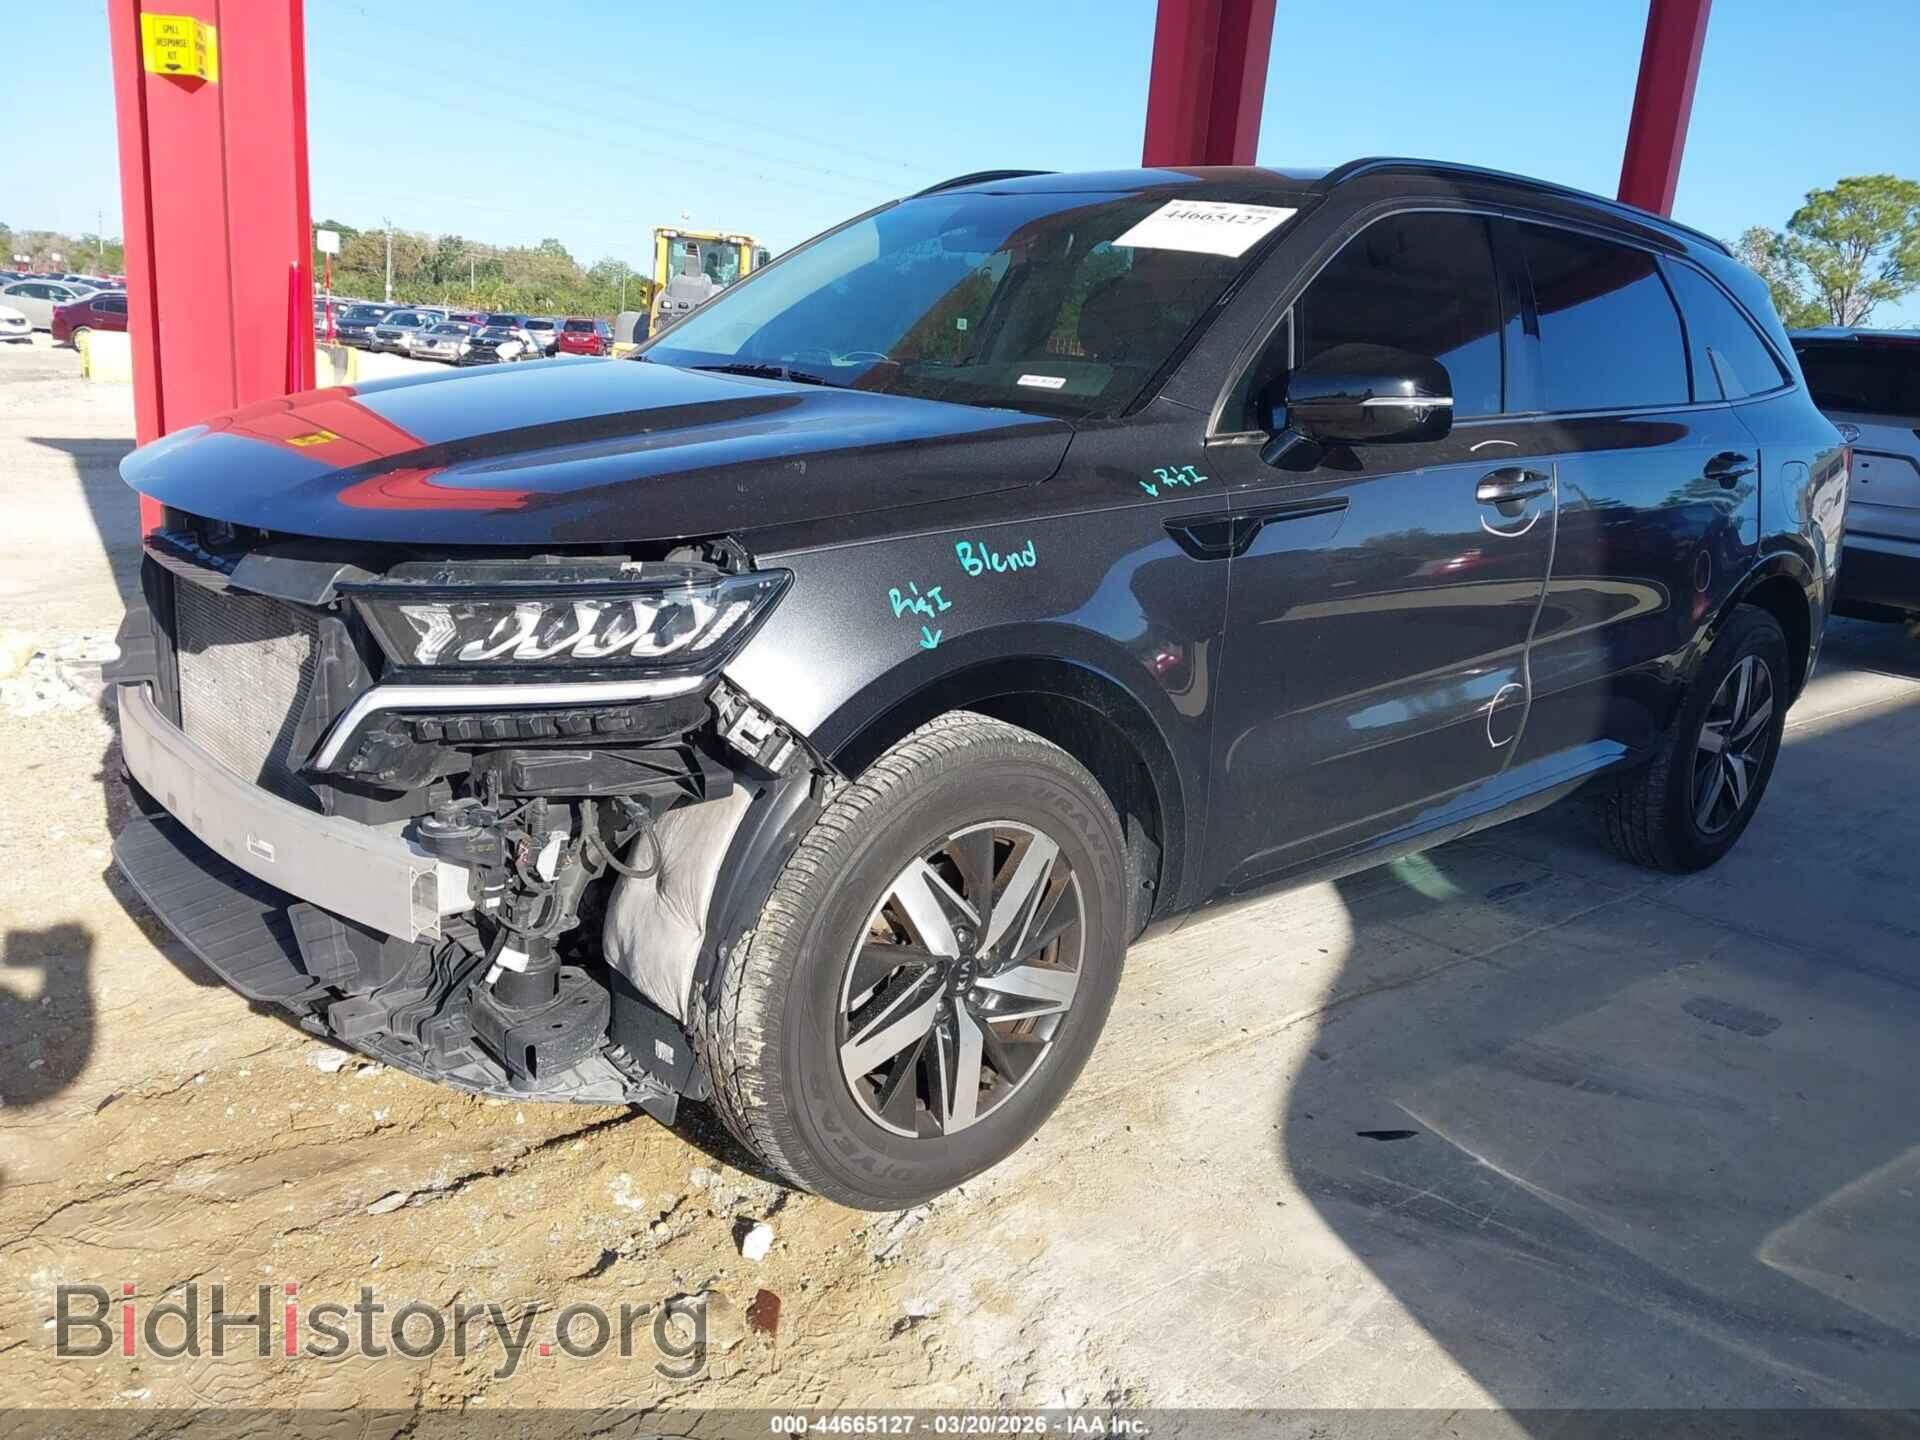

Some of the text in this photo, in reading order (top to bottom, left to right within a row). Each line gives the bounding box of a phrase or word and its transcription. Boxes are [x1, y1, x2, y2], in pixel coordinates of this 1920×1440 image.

[162, 24, 180, 35] SPILL
[156, 38, 188, 49] RESPONSE
[167, 51, 177, 61] KIT
[955, 539, 1038, 577] Blend
